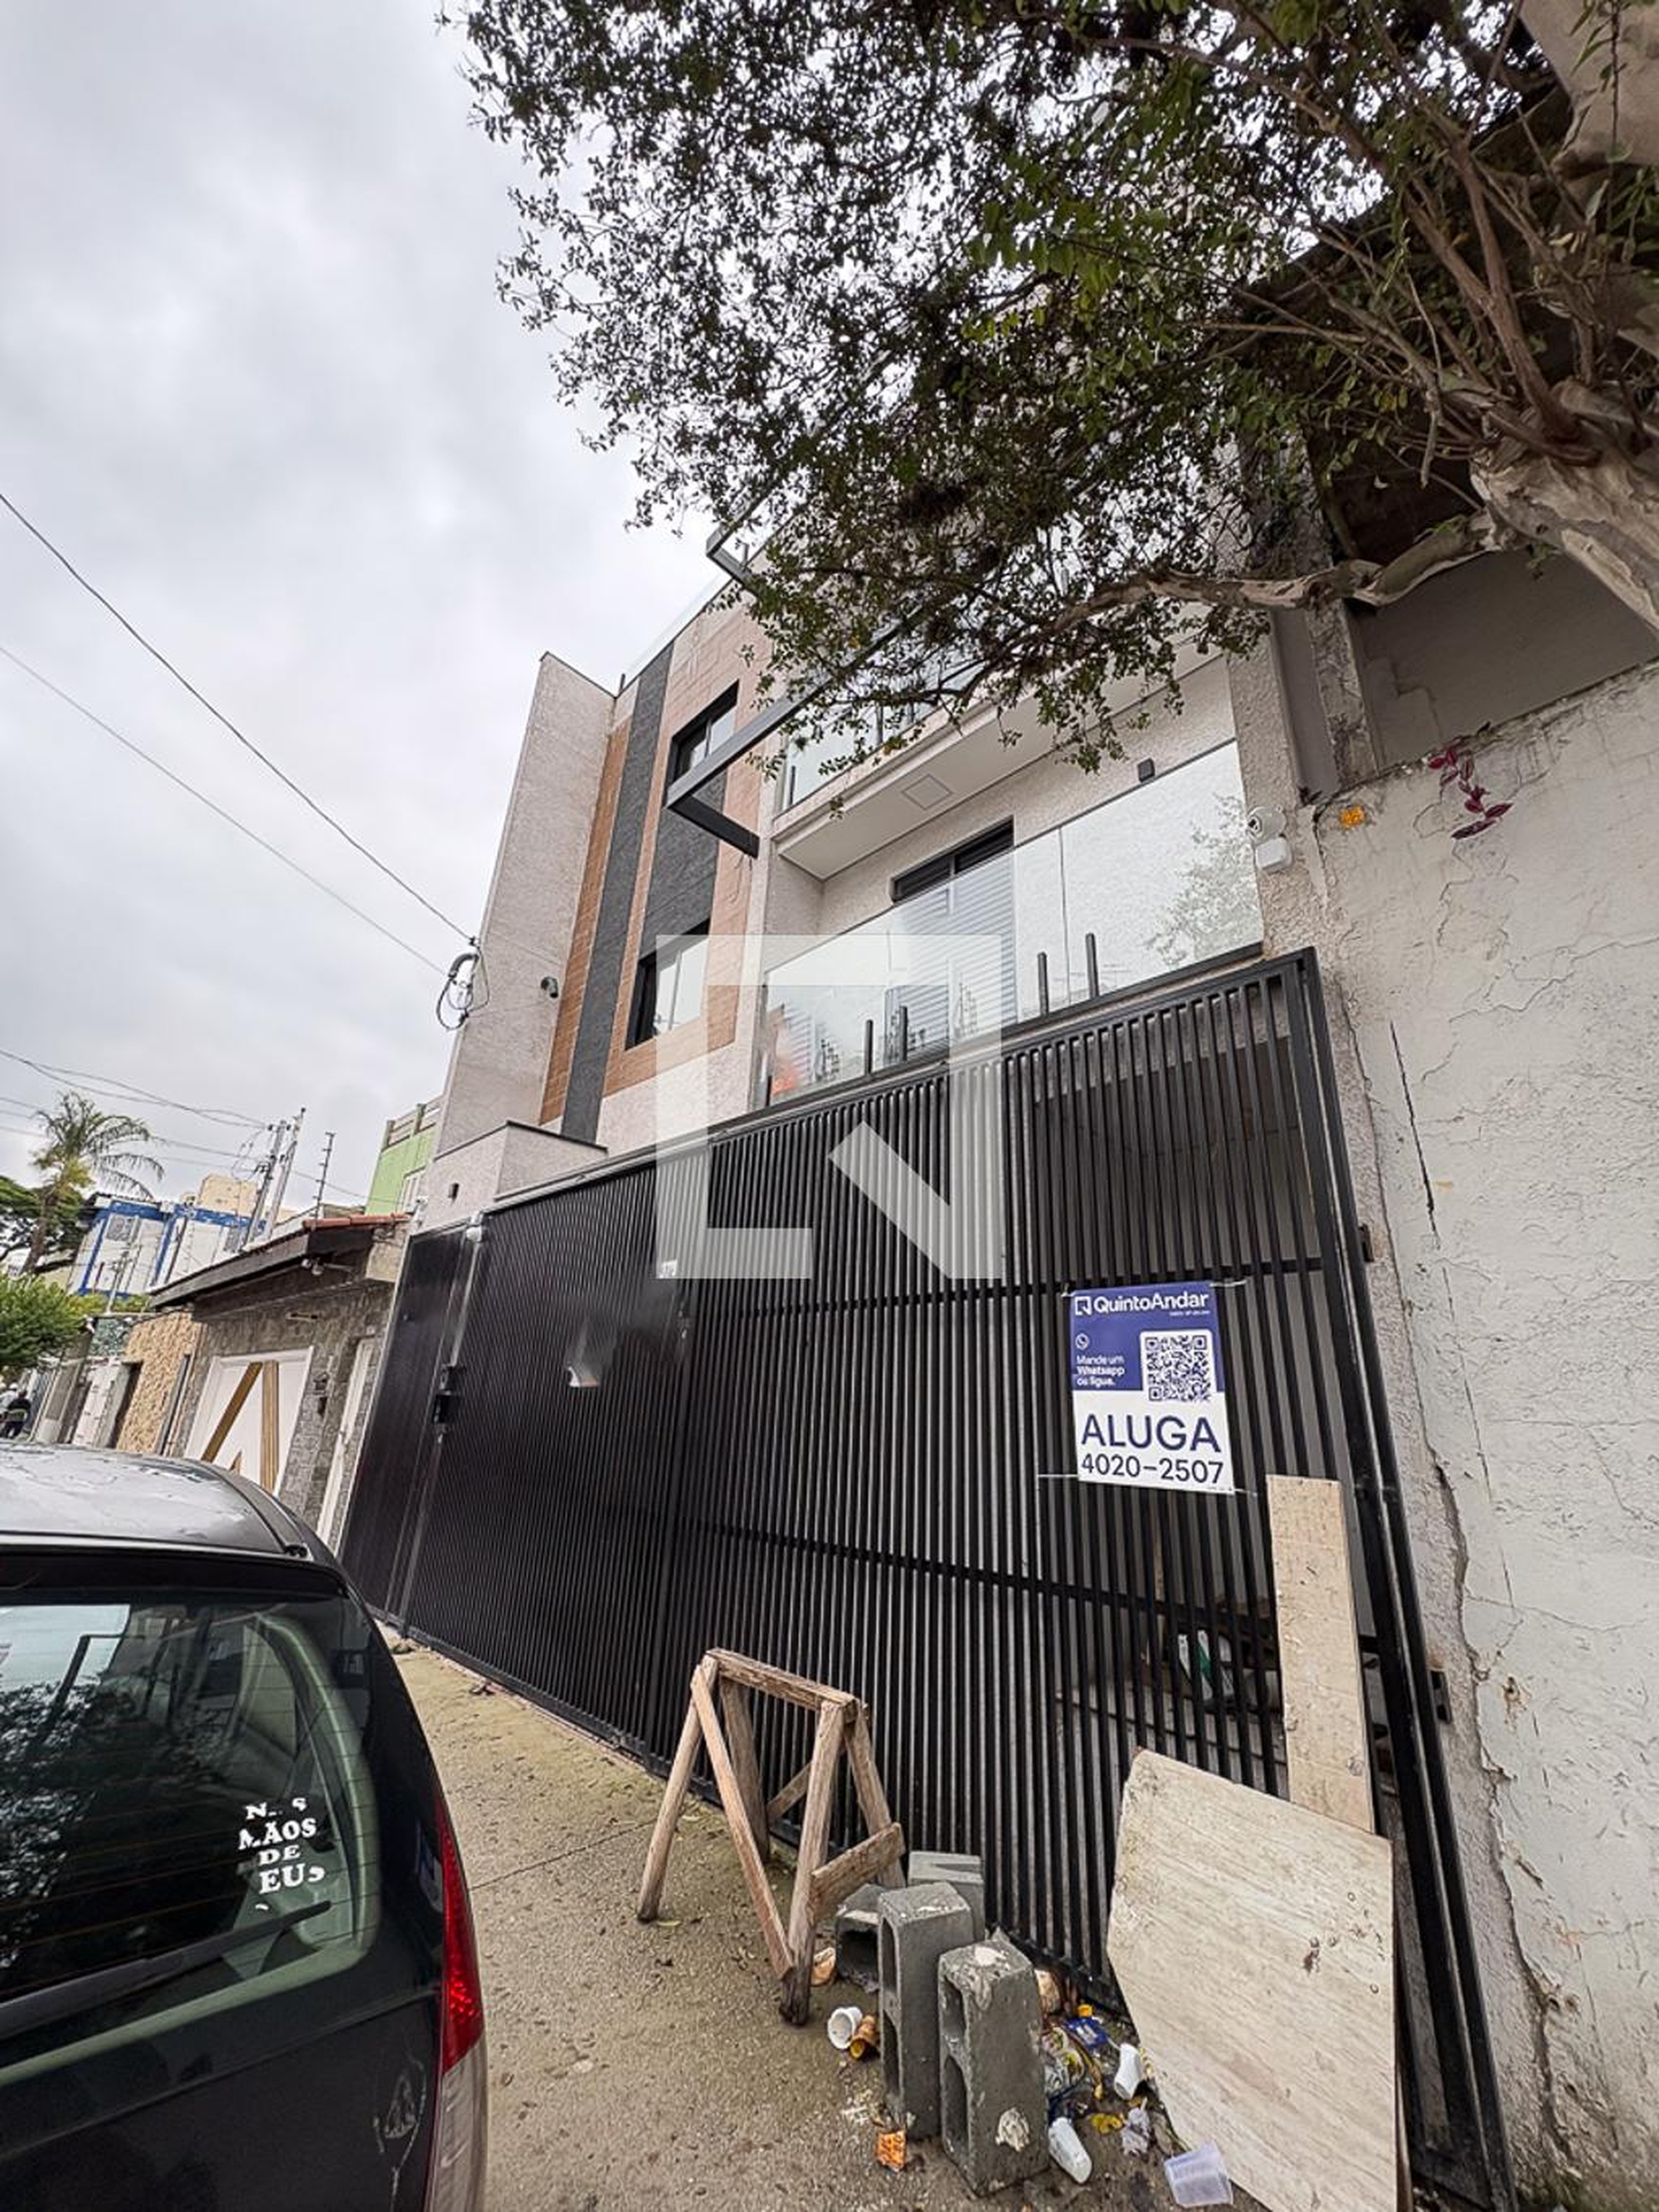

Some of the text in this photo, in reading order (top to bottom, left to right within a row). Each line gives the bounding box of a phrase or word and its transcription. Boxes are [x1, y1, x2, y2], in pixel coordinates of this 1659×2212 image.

[1093, 1291, 1209, 1313] QuintoAndar
[1081, 1414, 1221, 1453] ALUGA
[1081, 1453, 1224, 1484] 4020-2507
[258, 1844, 301, 1865] DE
